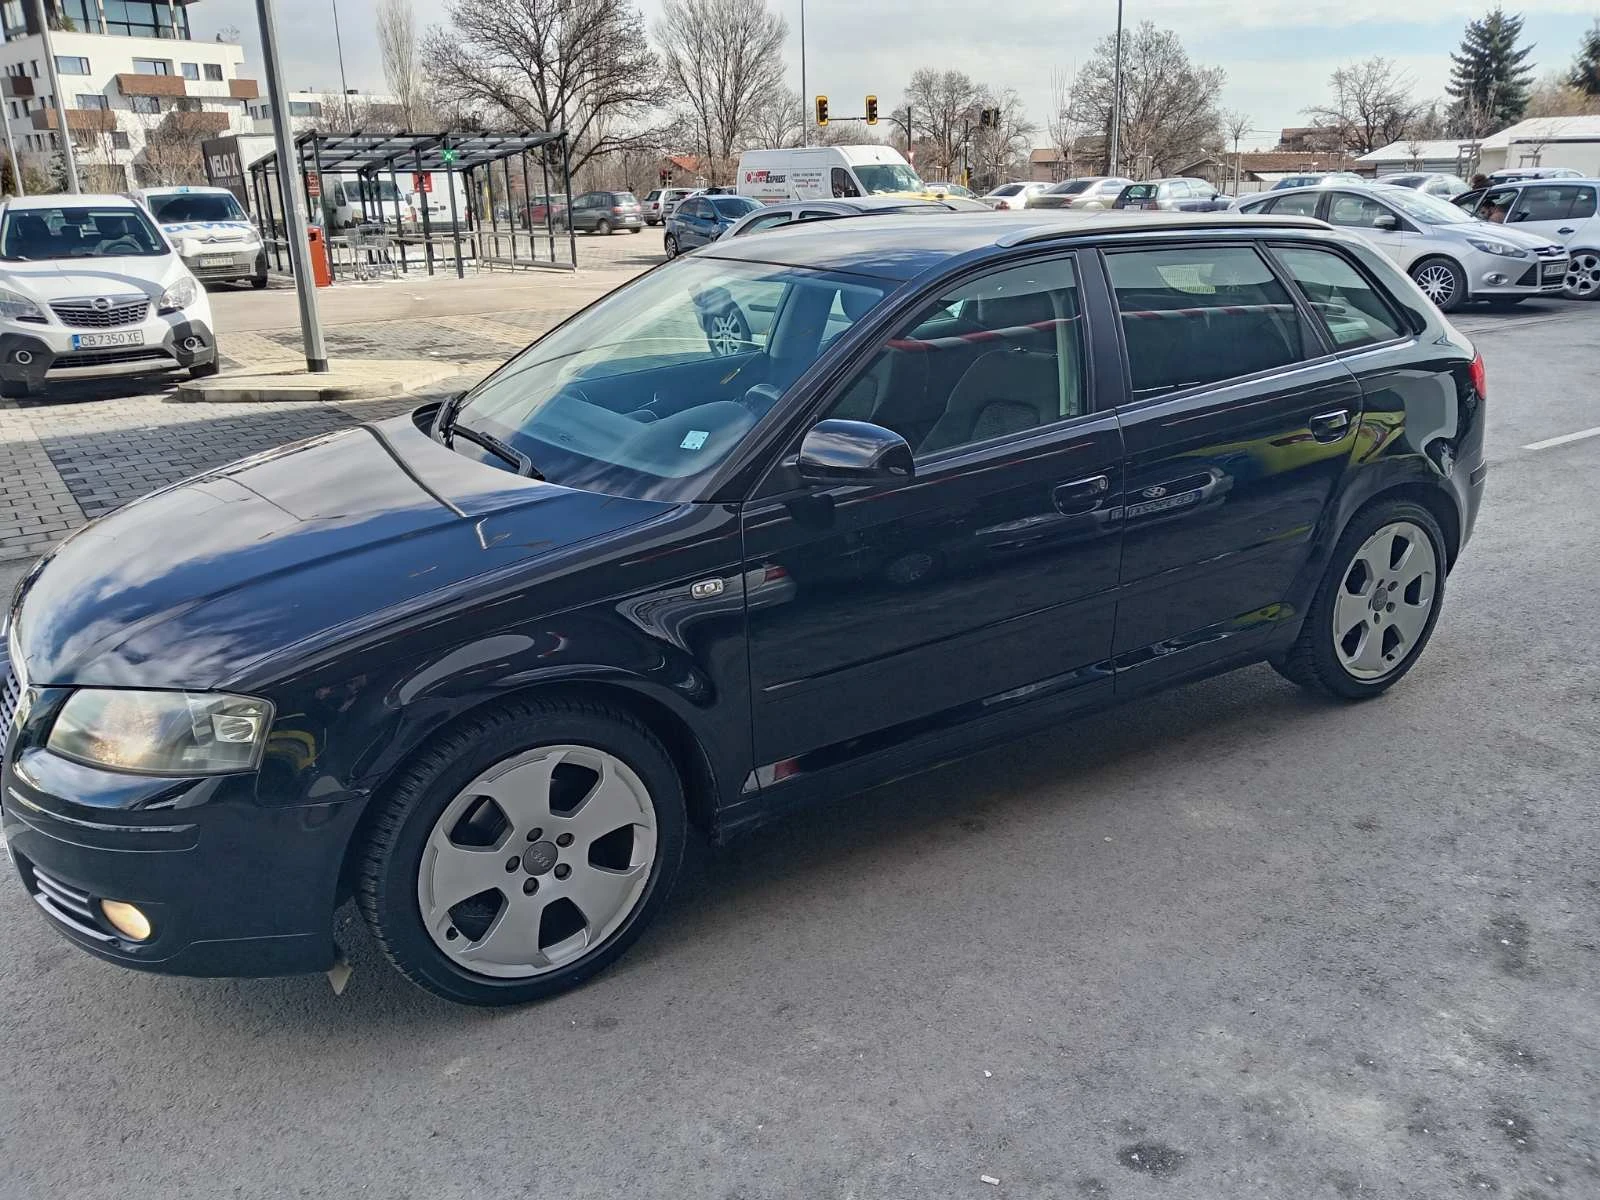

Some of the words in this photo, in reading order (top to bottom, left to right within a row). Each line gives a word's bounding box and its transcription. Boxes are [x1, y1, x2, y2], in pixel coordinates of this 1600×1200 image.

[81, 335, 96, 347] CB
[97, 333, 125, 345] 7350
[126, 331, 140, 343] XE
